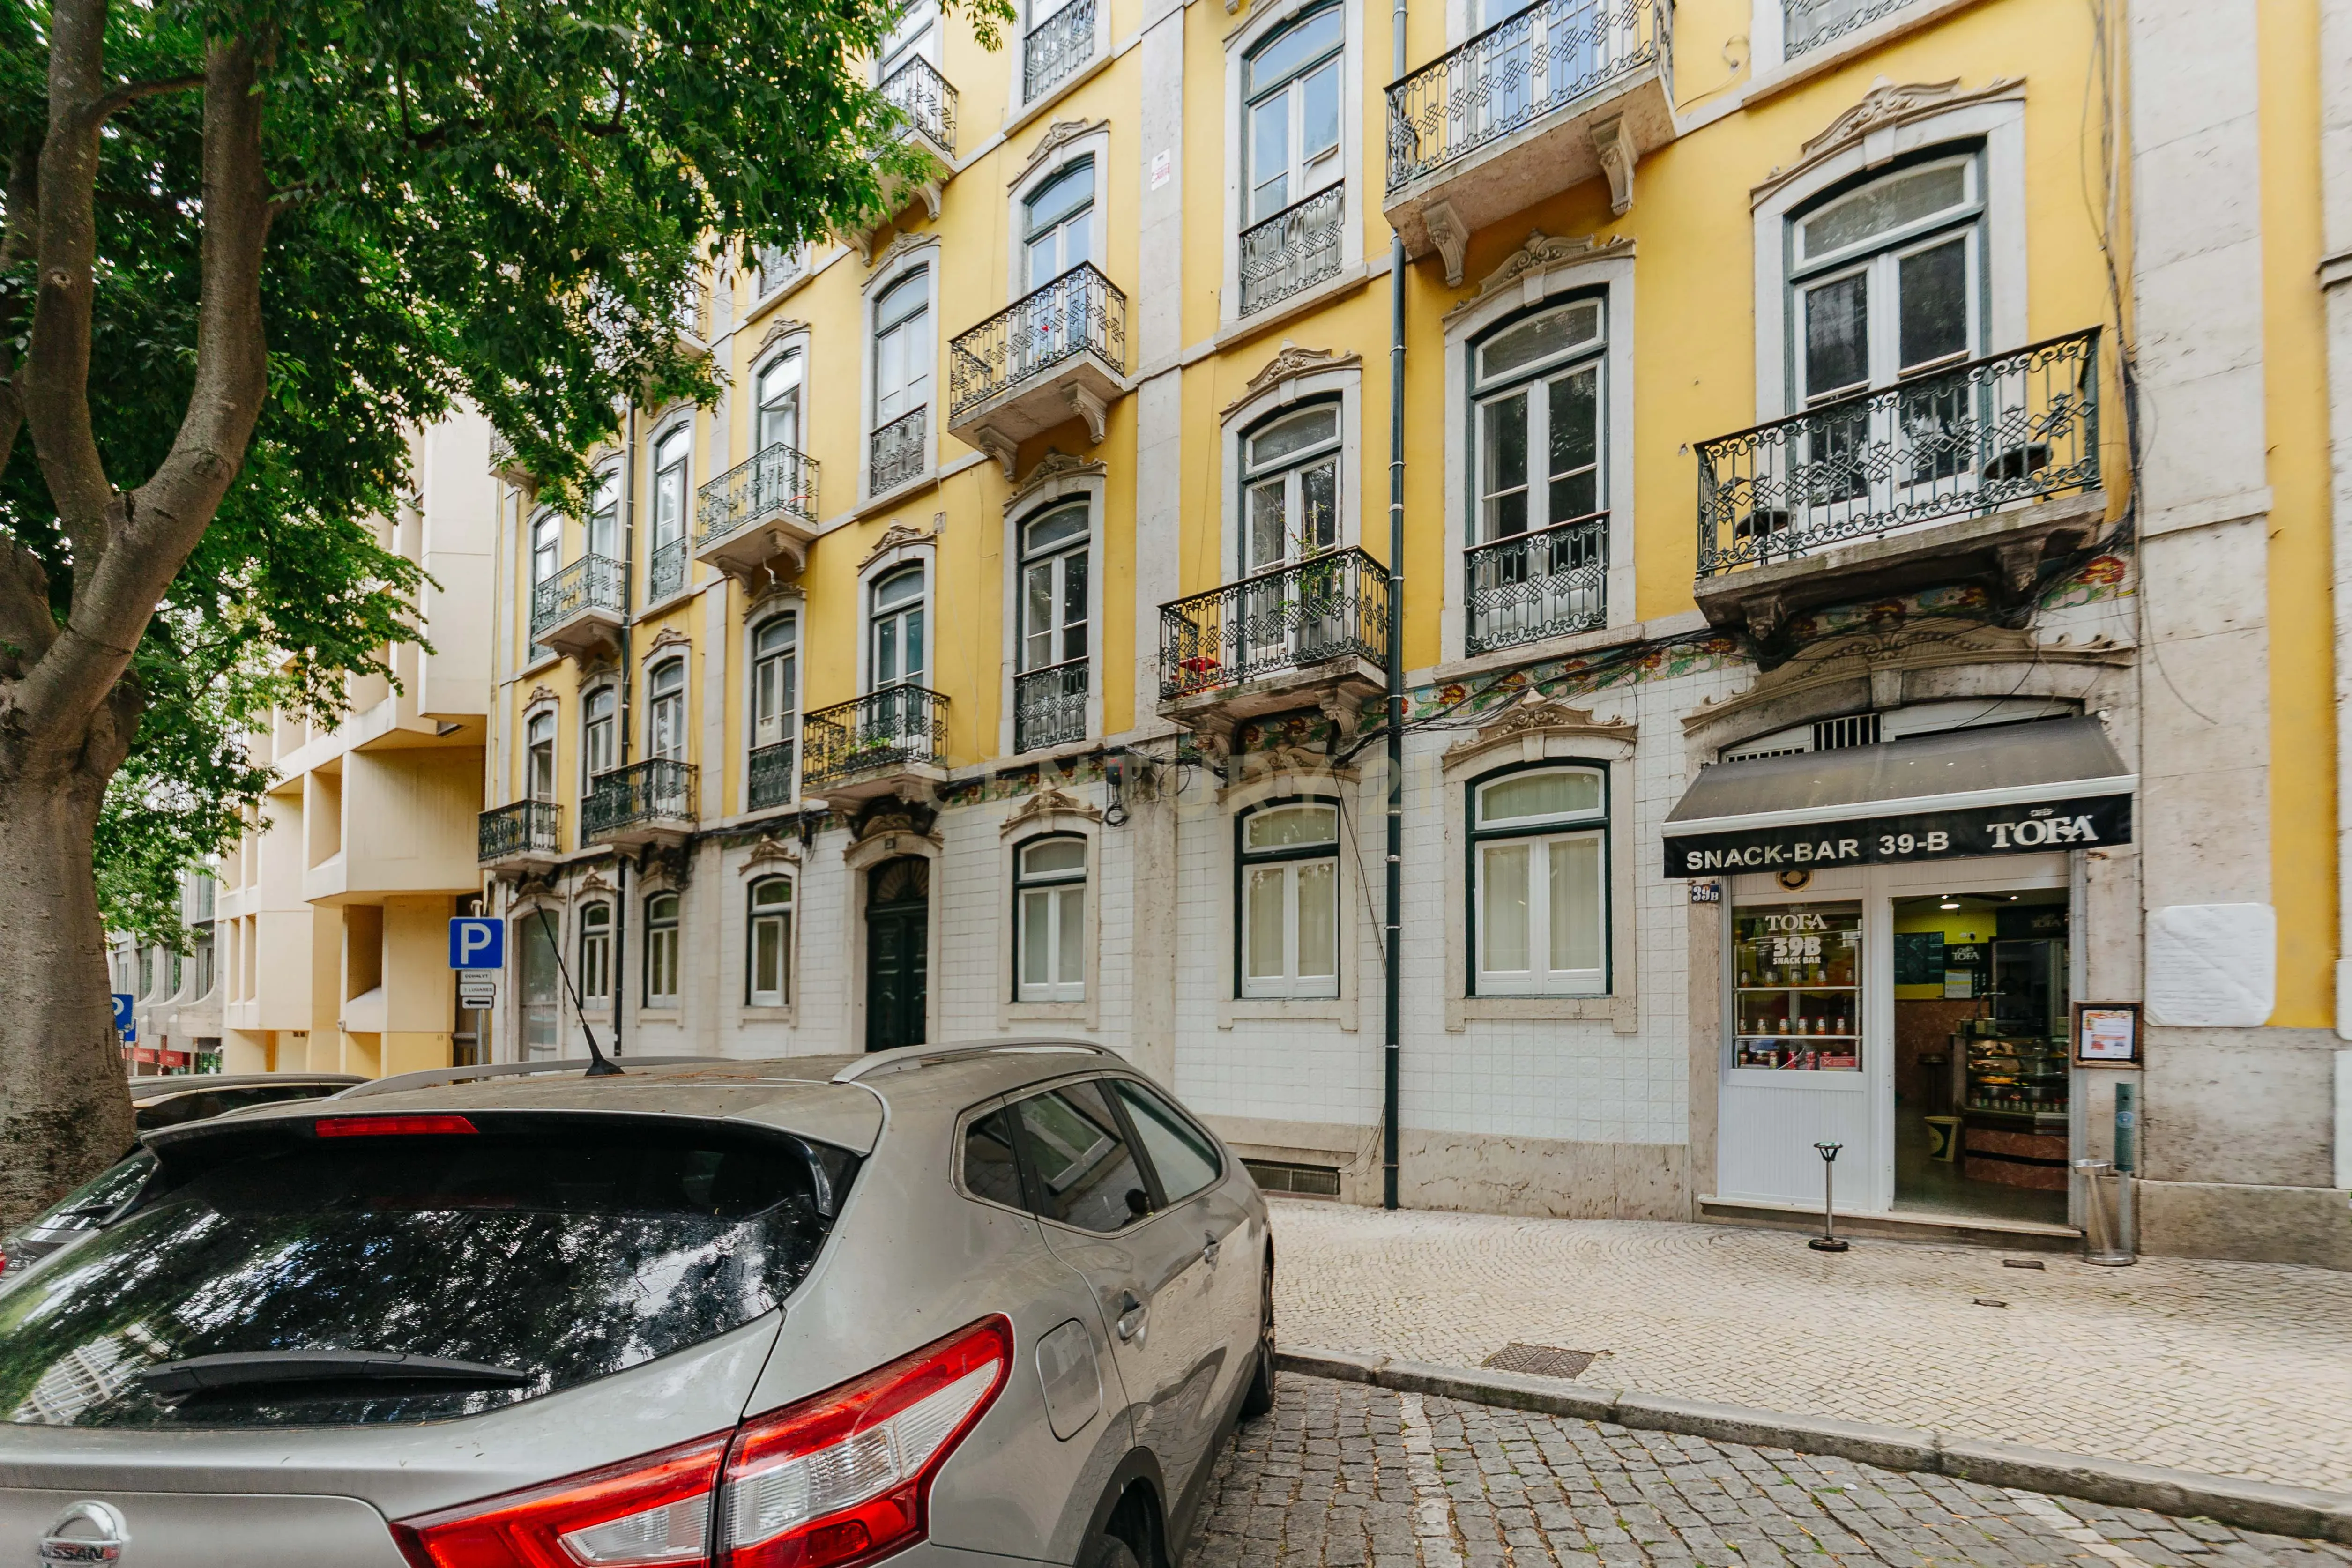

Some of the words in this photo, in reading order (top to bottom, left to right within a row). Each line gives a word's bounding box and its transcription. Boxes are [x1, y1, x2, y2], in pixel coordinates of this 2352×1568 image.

[1986, 815, 2099, 848] TOFA
[1686, 839, 1859, 870] SNACK-BAR
[1879, 831, 1949, 855] 39-B
[1765, 913, 1827, 931] TOFA
[461, 923, 492, 965] P
[1773, 936, 1822, 957] 39B
